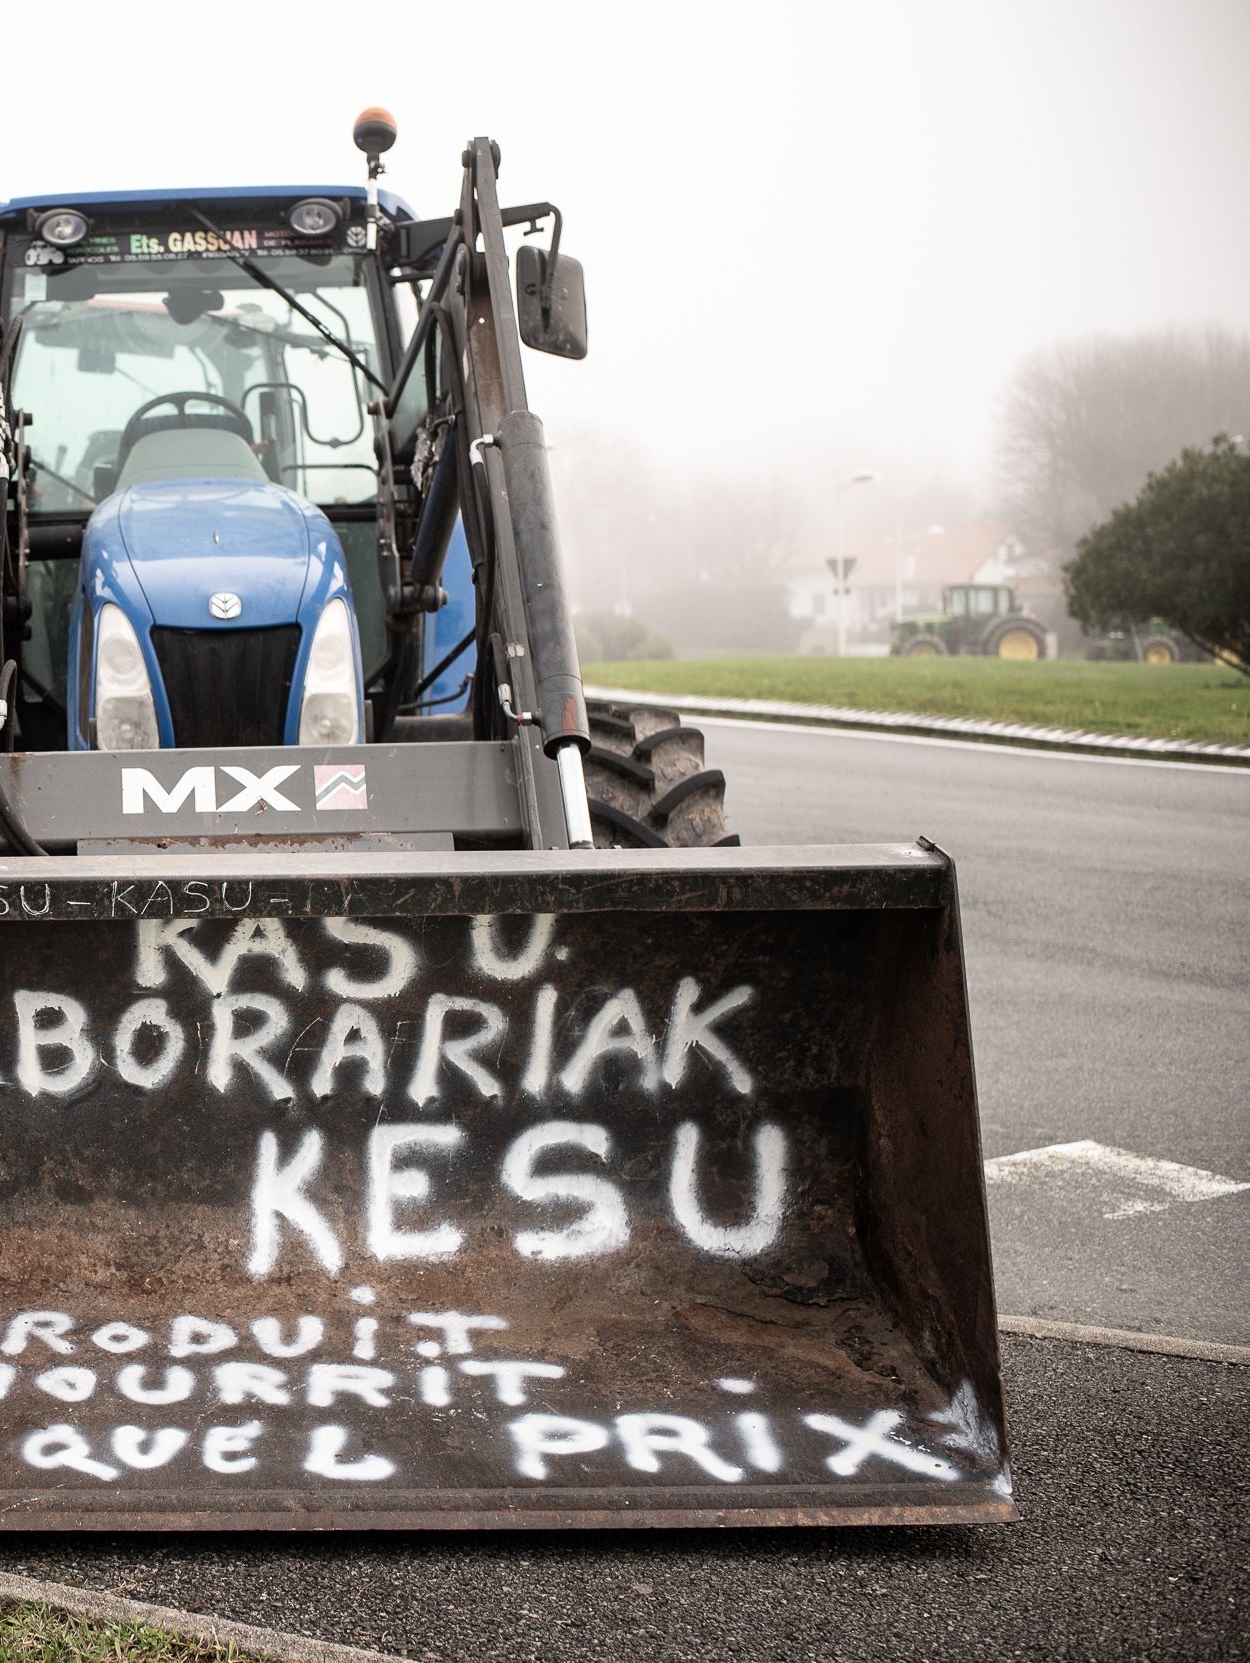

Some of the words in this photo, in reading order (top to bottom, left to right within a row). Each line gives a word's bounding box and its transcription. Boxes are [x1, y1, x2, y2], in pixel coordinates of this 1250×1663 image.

[130, 233, 165, 254] Ets.
[121, 765, 302, 815] MX
[110, 880, 253, 917] KASU
[248, 1121, 788, 1276] KESU
[20, 1419, 398, 1482] QUEL
